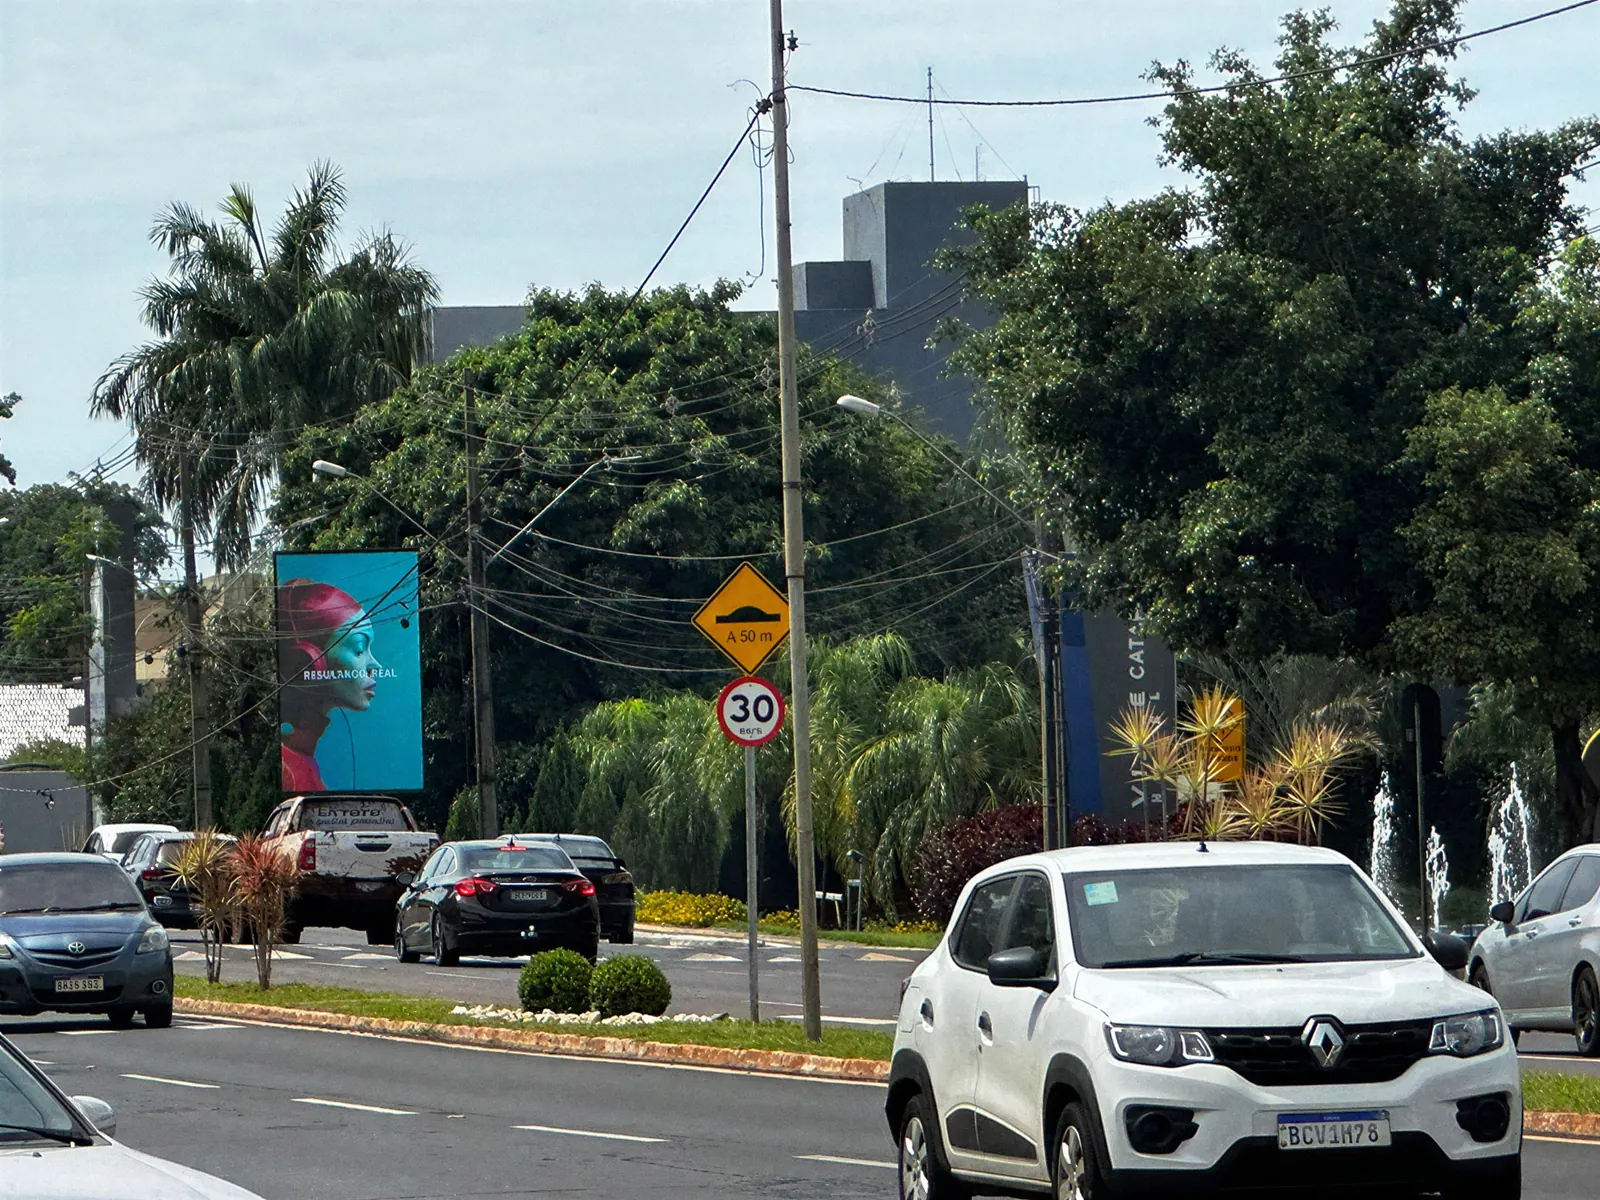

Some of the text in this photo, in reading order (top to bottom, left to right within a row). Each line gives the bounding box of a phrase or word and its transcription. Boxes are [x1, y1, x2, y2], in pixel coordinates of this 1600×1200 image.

[726, 630, 772, 643] A 50 m
[730, 694, 774, 723] 30
